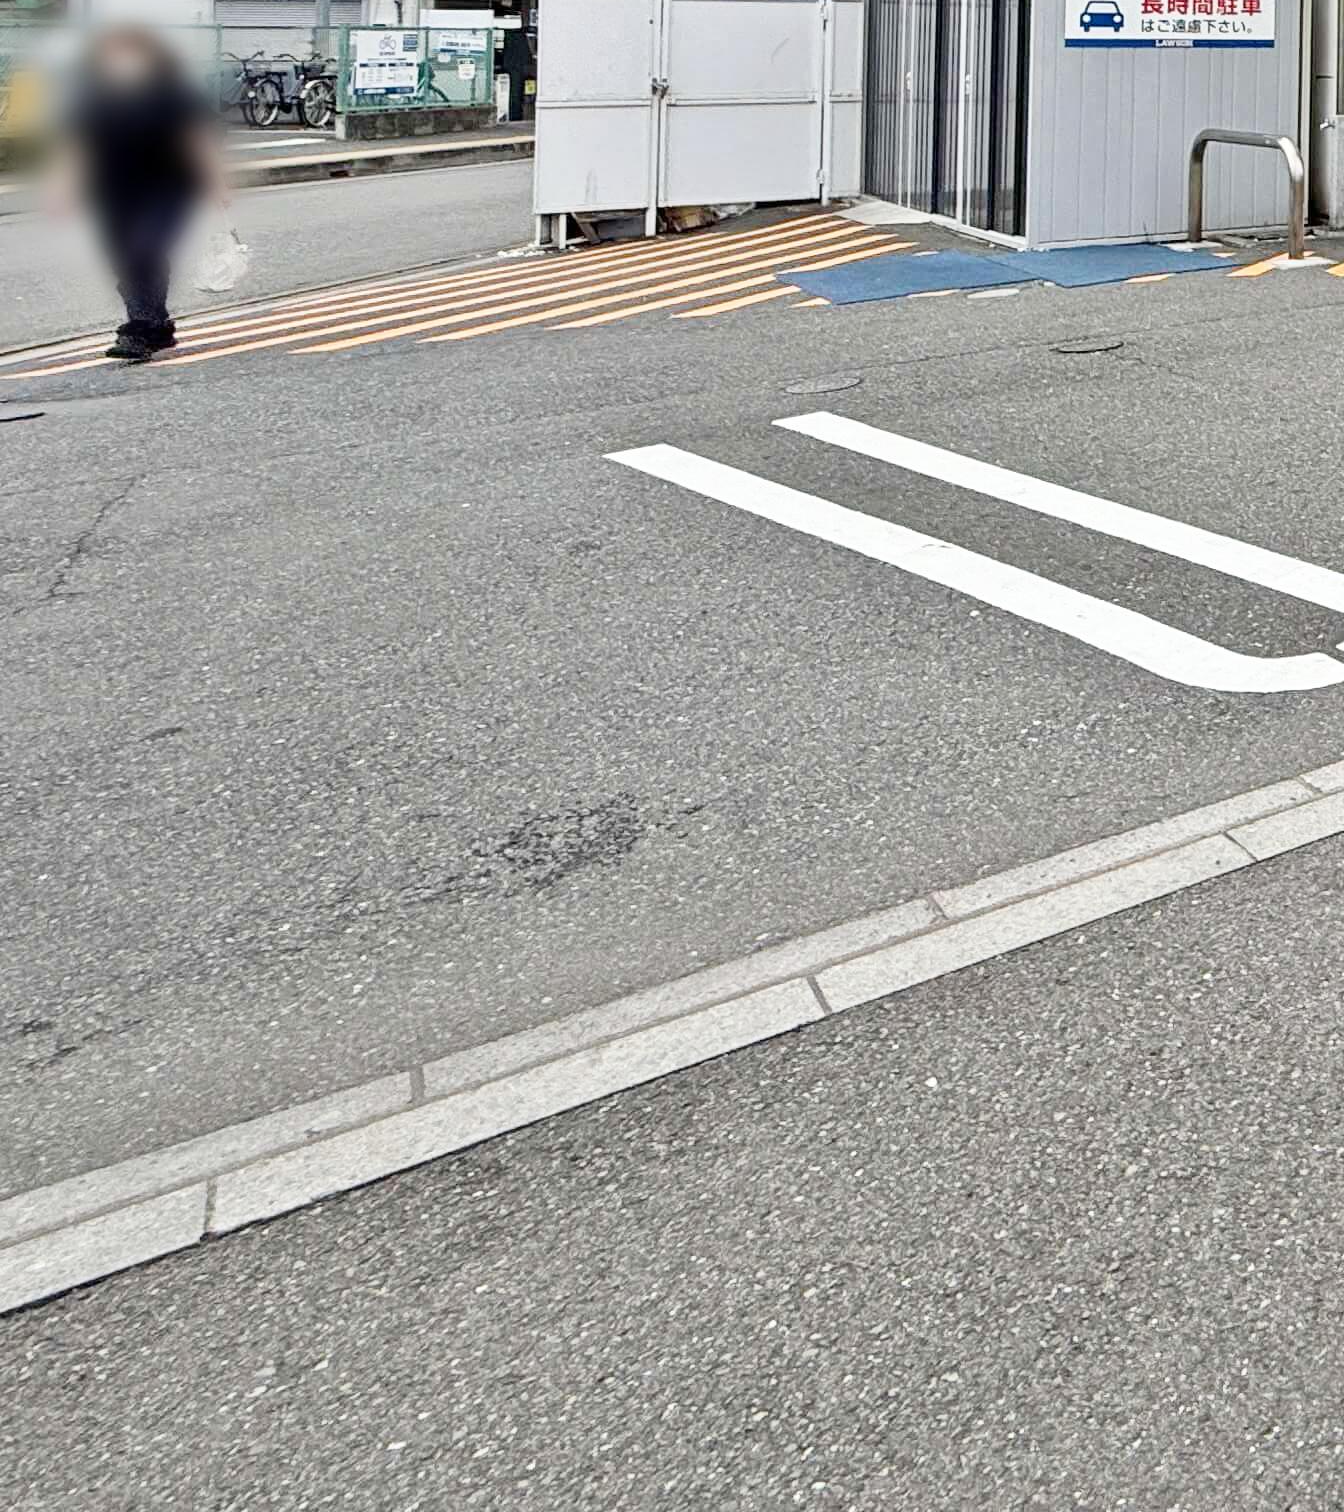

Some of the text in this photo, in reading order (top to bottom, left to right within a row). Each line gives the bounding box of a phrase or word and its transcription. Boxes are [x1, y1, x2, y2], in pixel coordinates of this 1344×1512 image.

[1141, 19, 1253, 34] はご遠慮下さい。
[1155, 39, 1194, 47] LAWSON
